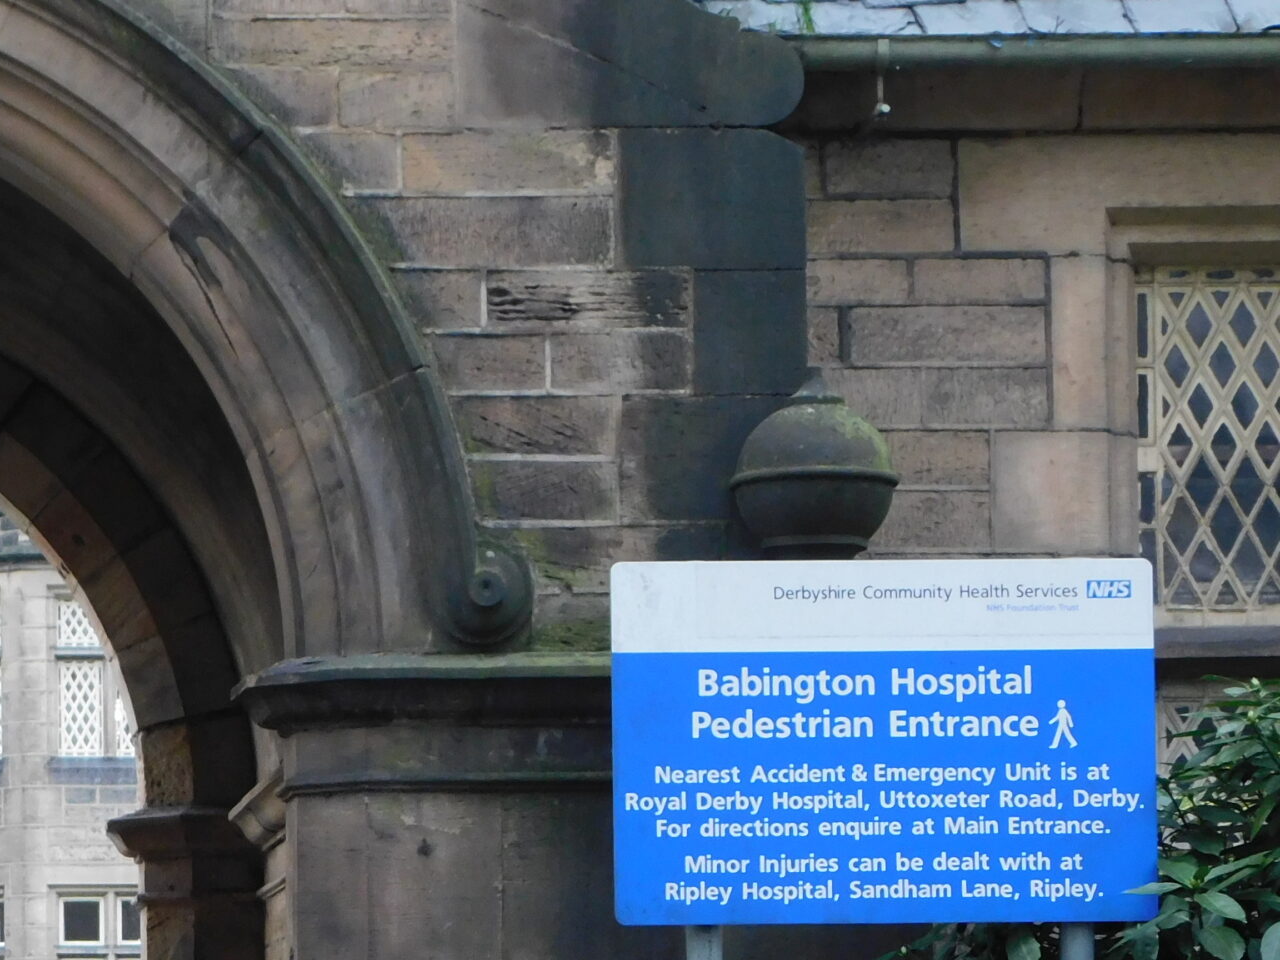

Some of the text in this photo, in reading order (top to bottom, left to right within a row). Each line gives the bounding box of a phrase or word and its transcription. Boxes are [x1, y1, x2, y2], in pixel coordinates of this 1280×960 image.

[773, 582, 1078, 603] Derbyshire Community Health Services
[1087, 580, 1131, 598] NHS
[986, 603, 1080, 612] NHS Foundation Trust
[698, 664, 1032, 704] Babington Hospital
[692, 708, 1039, 739] Pedestrian Entrance
[655, 761, 1110, 787] Nearest Accident & Emergency Unit is at
[625, 787, 1144, 816] Royal Derby Hospital, Uttoxeter Road, Derby.
[656, 815, 1111, 841] For directions enquire at Main Entrance.
[684, 851, 1083, 878] Minor Injuries can be dealt with at
[665, 878, 1104, 905] Ripley Hospital, Sandham Lane, Ripley.
